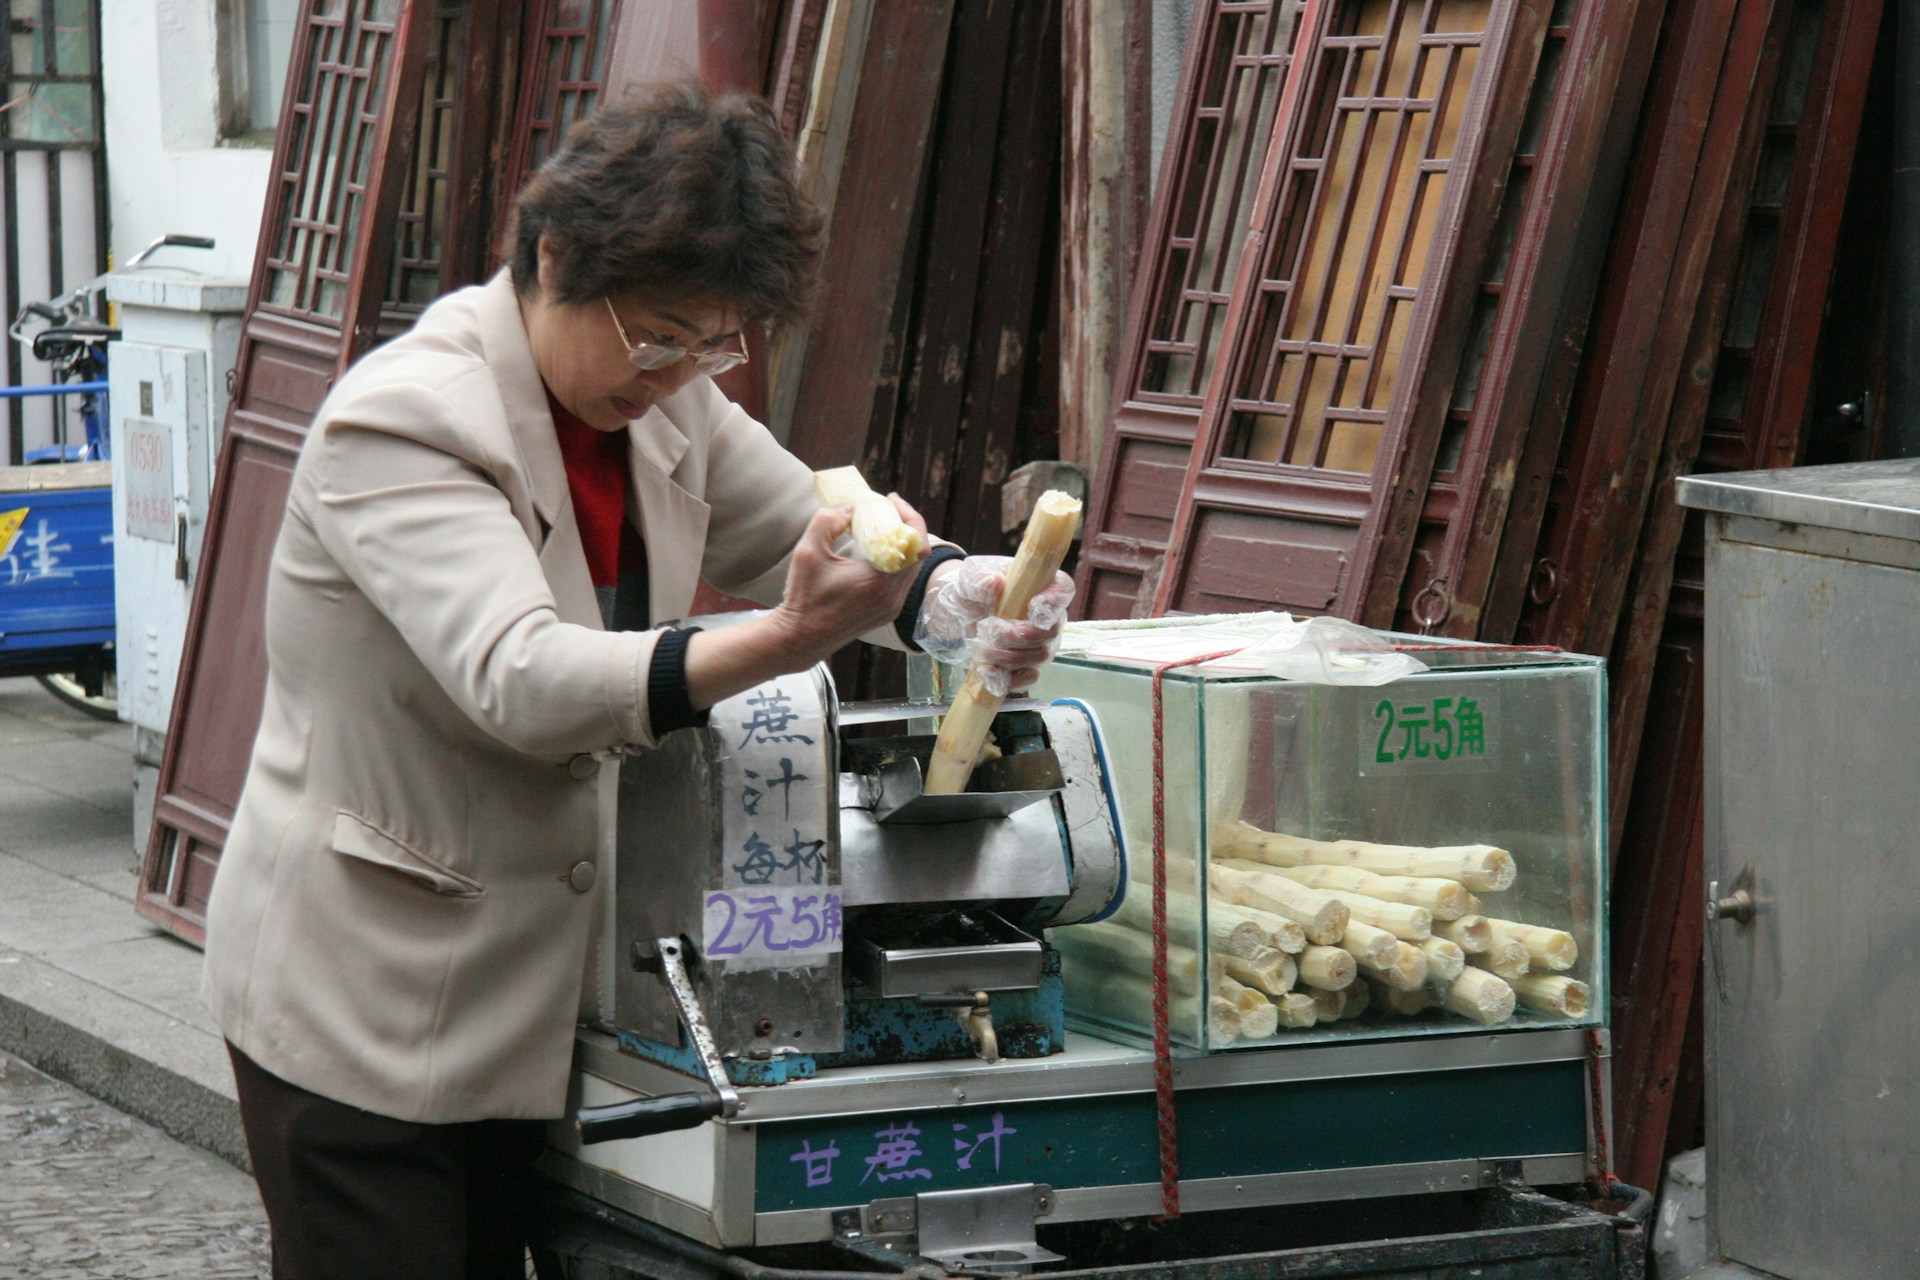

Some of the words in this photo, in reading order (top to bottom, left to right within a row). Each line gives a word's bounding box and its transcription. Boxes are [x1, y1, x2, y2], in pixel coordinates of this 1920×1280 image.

[131, 431, 163, 472] 0530
[1375, 696, 1485, 763] 2元5角
[706, 893, 843, 955] 2元5角
[790, 1112, 1017, 1187] 甘蔗汁
